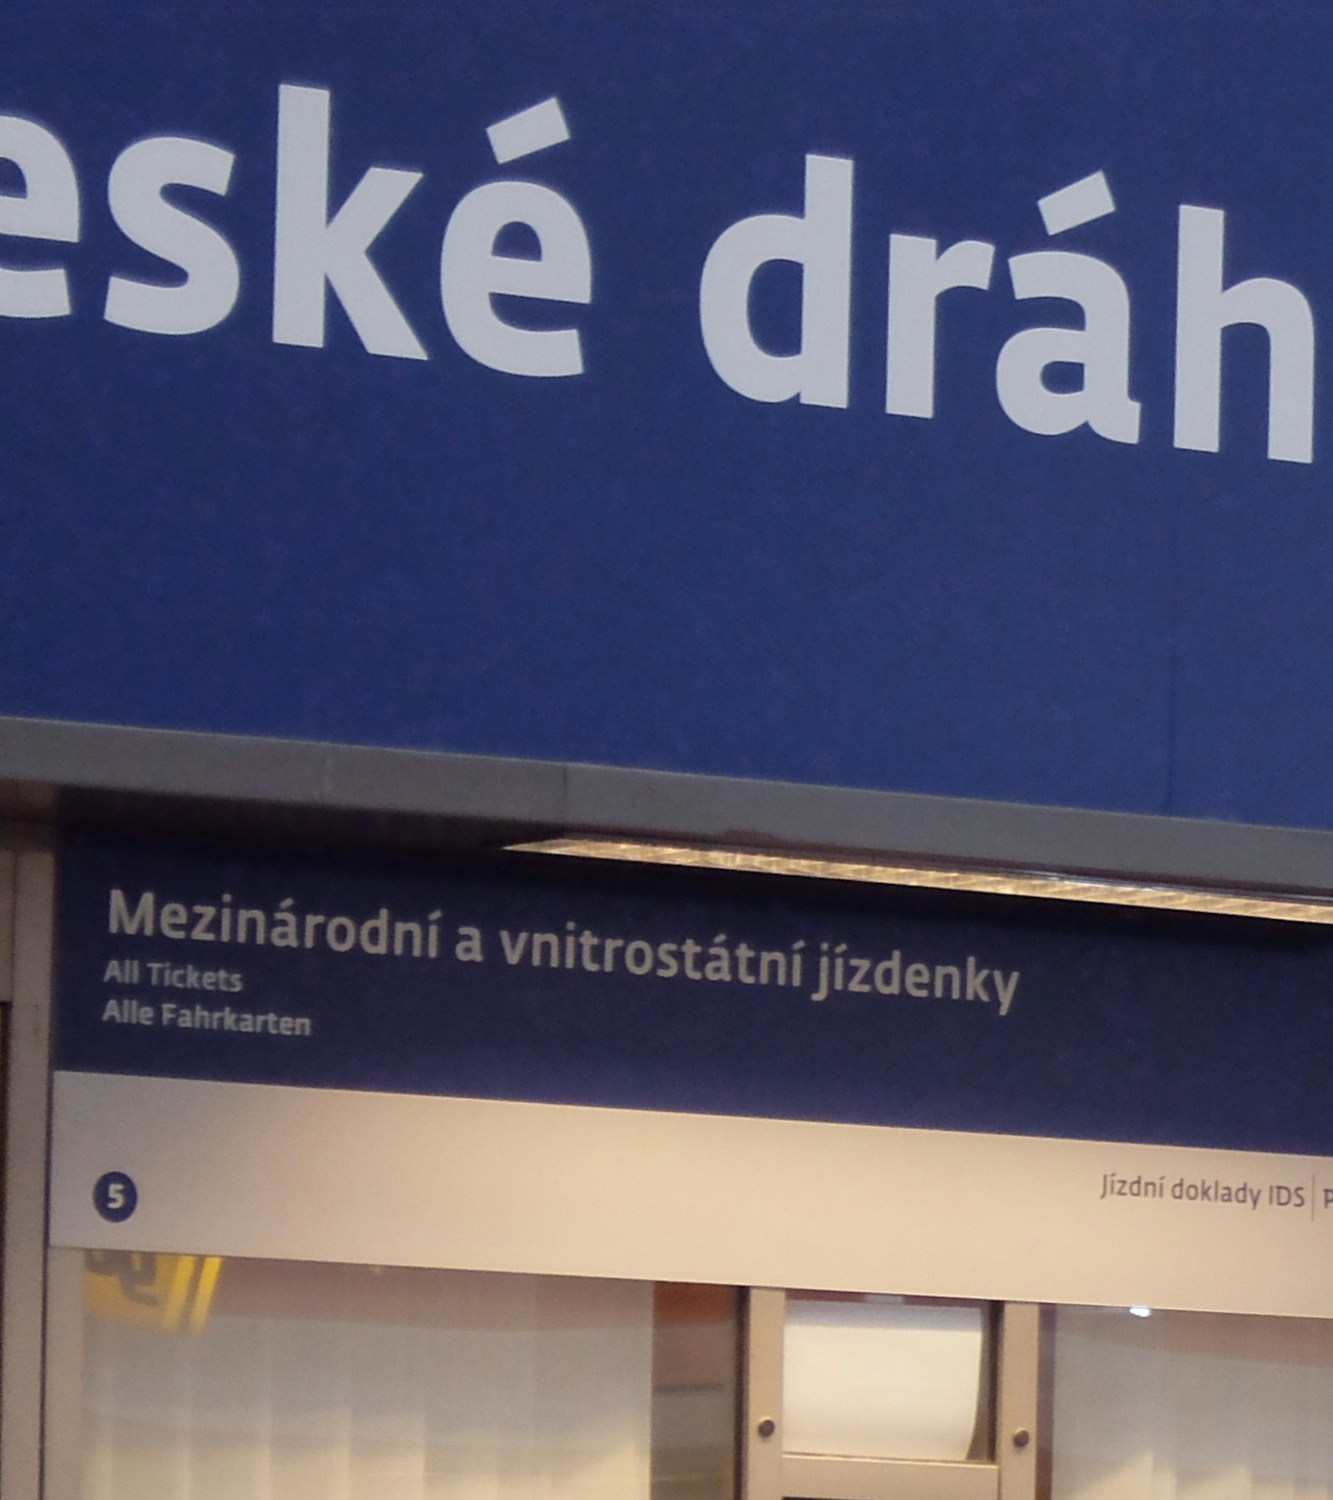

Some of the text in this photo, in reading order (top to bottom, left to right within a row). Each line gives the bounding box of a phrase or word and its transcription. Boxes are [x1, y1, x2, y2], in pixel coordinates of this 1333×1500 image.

[108, 887, 1022, 1017] Mezinárodní a vnitrostátní jízdenky
[103, 959, 243, 993] All Tickets
[101, 999, 312, 1036] Alle Fahrkarten
[107, 1183, 125, 1209] 5
[1100, 1172, 1306, 1211] Jízdní doklady IDS
